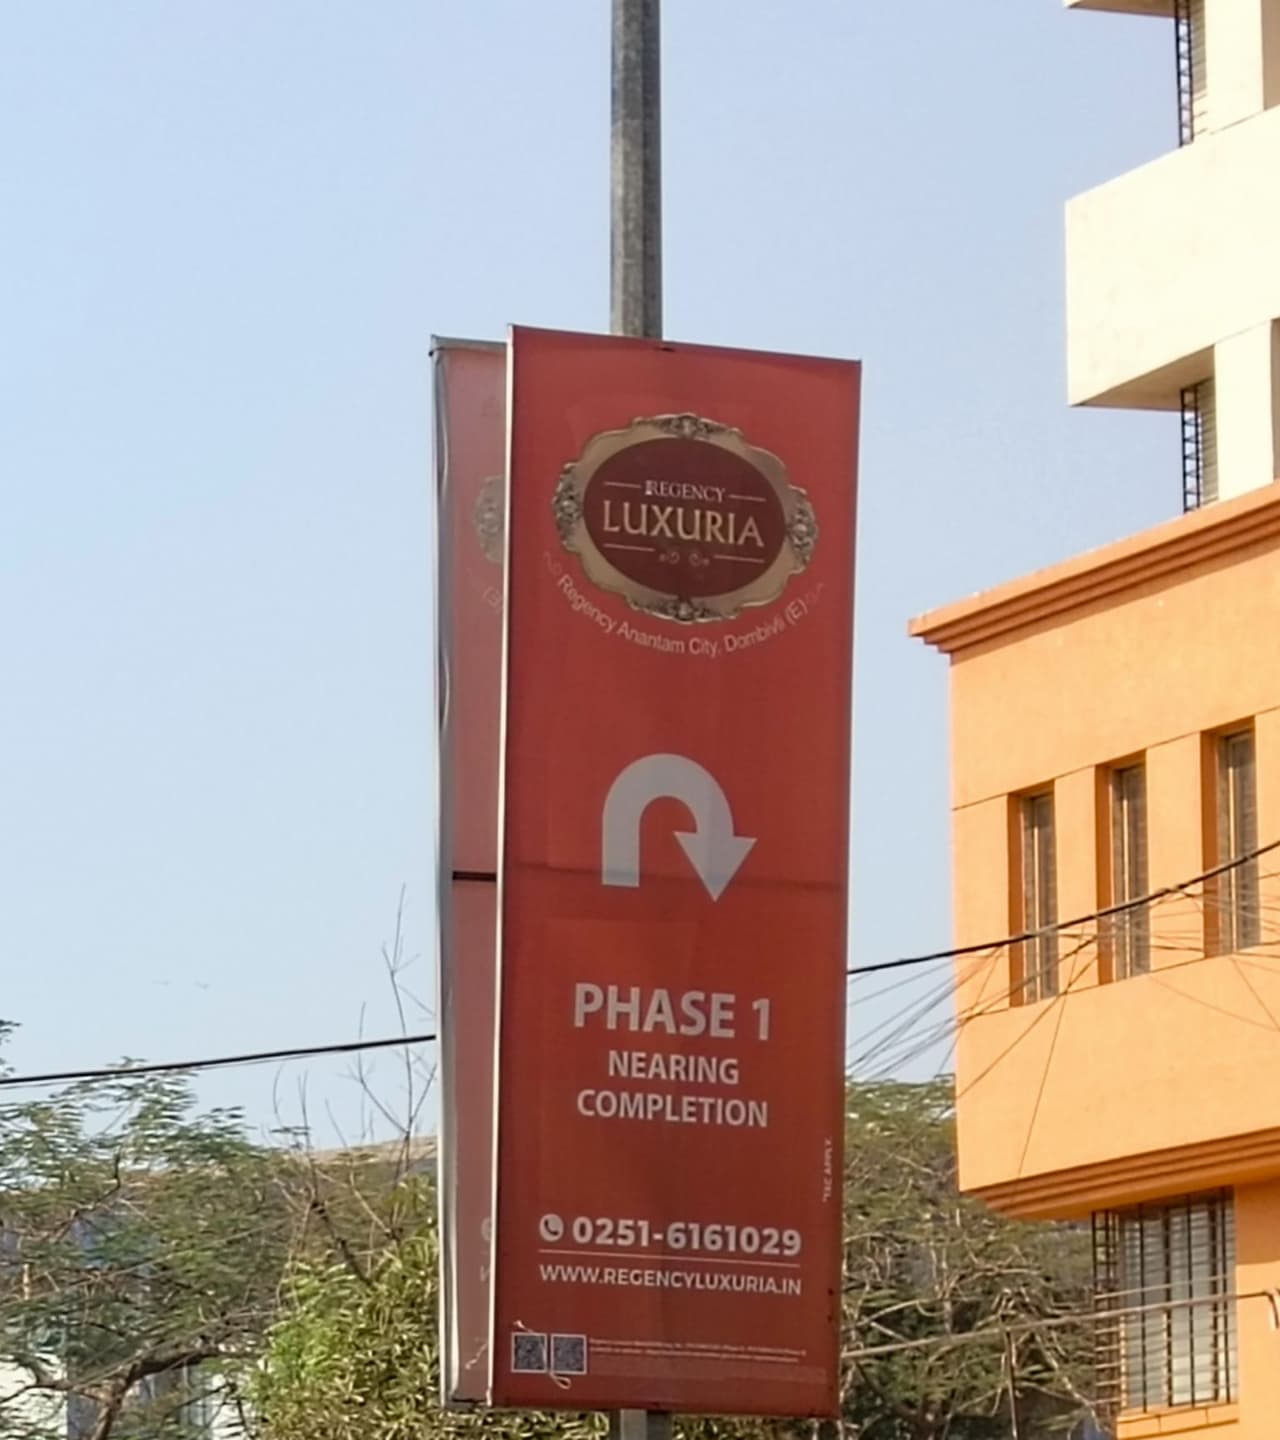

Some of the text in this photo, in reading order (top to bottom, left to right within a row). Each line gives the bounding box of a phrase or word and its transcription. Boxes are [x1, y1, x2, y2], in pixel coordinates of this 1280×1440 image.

[644, 480, 726, 502] REGENCY
[602, 500, 764, 547] LUXURIA
[557, 573, 616, 632] Regency
[617, 621, 686, 653] Anantam
[784, 597, 809, 626] (E)
[573, 982, 770, 1041] PHASE 1
[608, 1050, 739, 1085] NEARING
[576, 1089, 769, 1128] COMPLETION
[571, 1216, 802, 1256] 0251-6161029
[539, 1264, 802, 1296] WWW.REGENCYLUXURIA.IN
